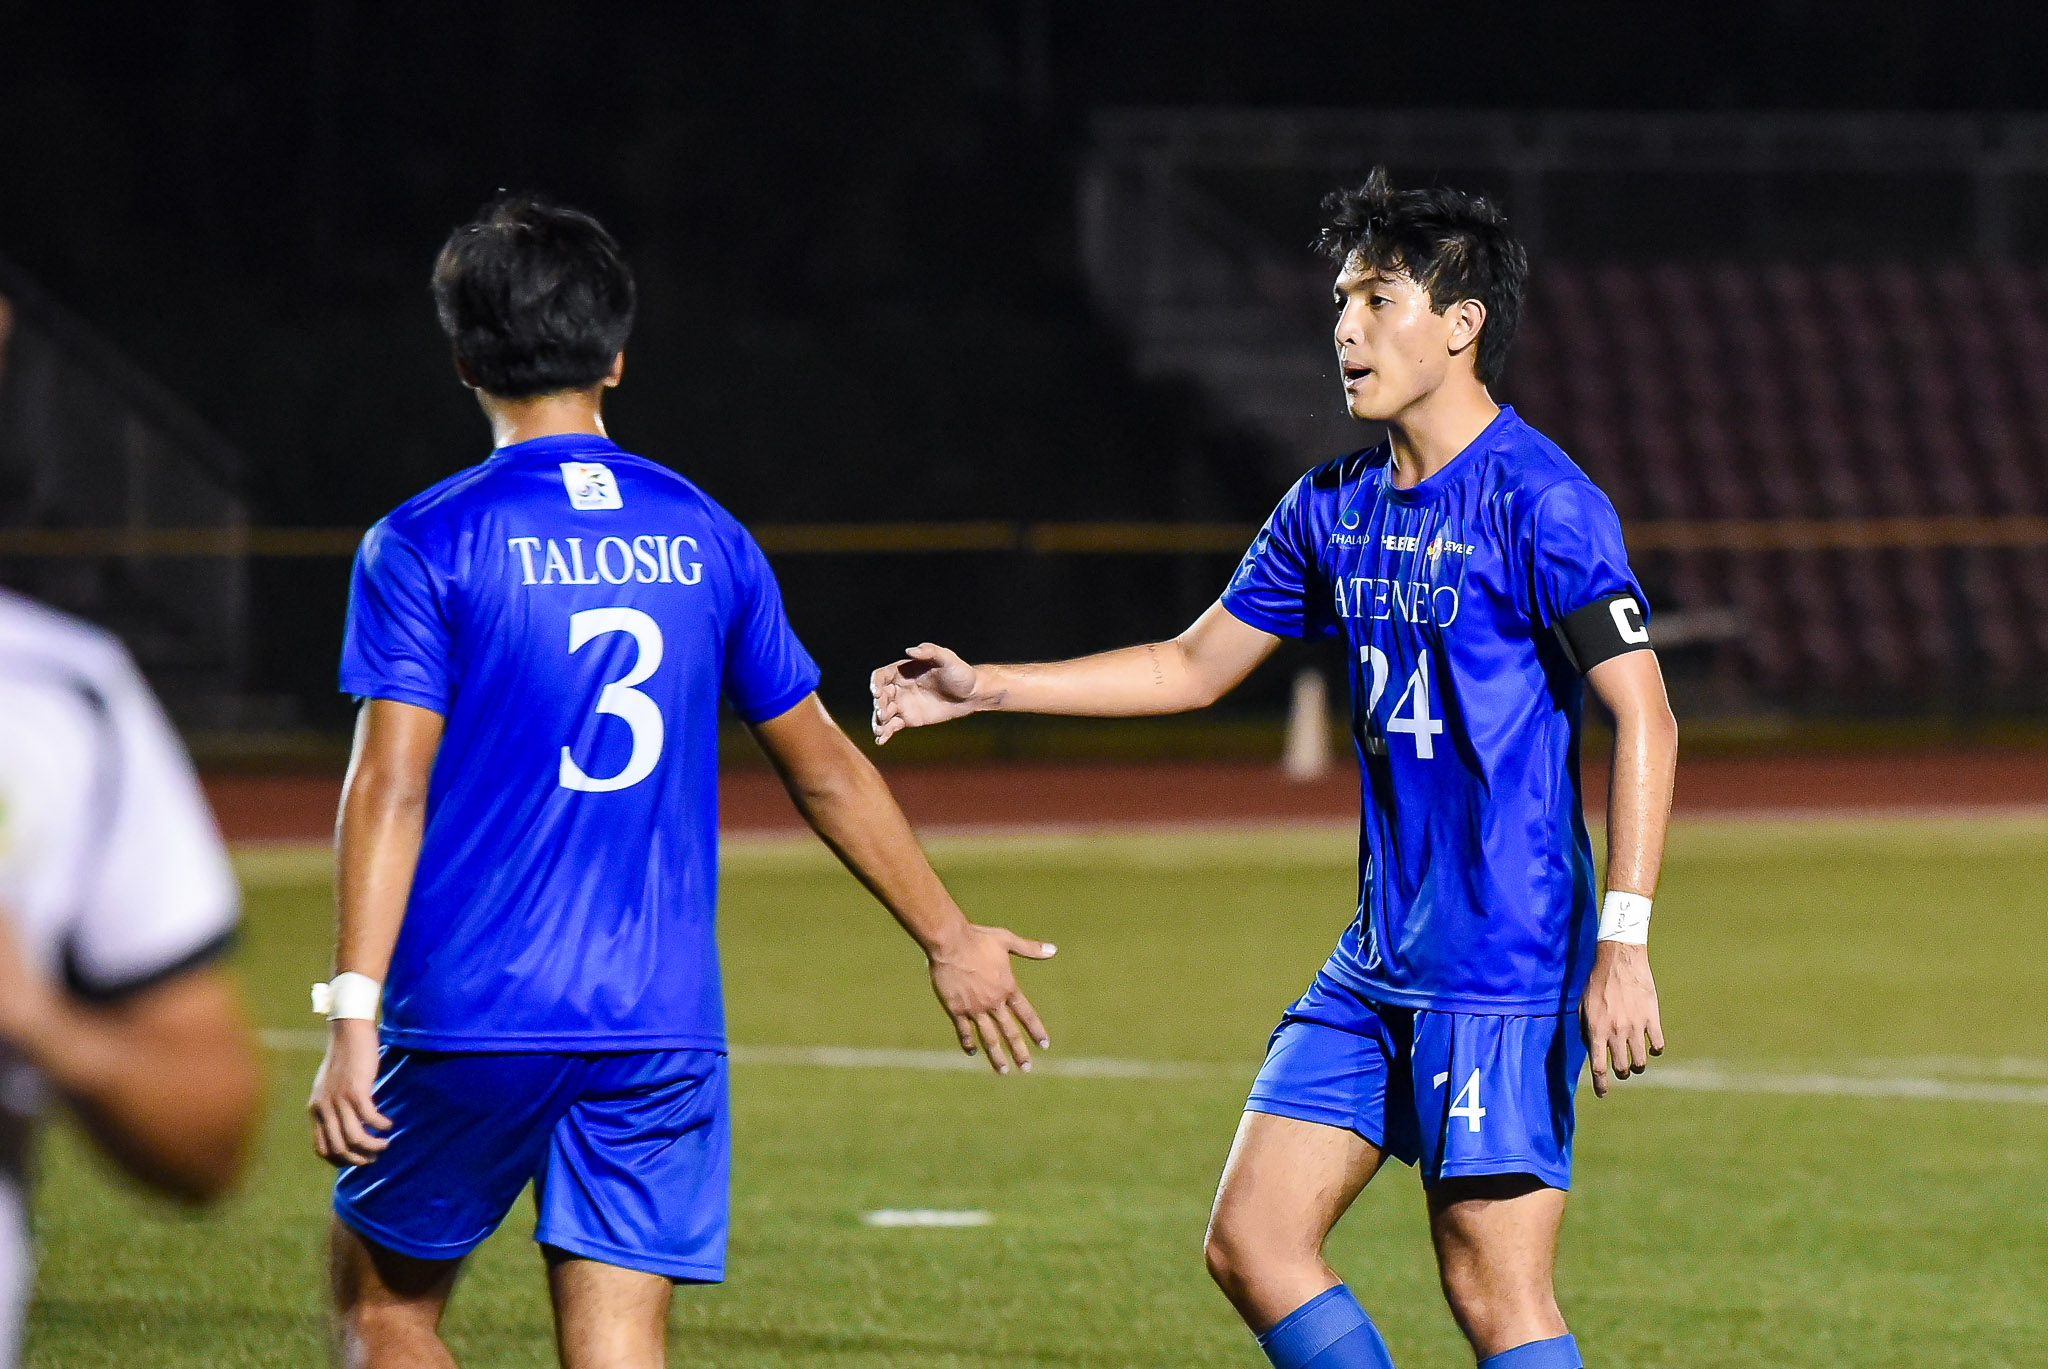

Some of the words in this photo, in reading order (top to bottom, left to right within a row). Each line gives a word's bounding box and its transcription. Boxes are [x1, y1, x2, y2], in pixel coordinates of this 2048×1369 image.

[507, 535, 703, 586] TALOSIG
[1334, 575, 1459, 628] ATENEO
[1608, 597, 1649, 645] C
[559, 606, 665, 793] 3
[1359, 645, 1443, 759] 24
[1432, 1067, 1487, 1133] 4
